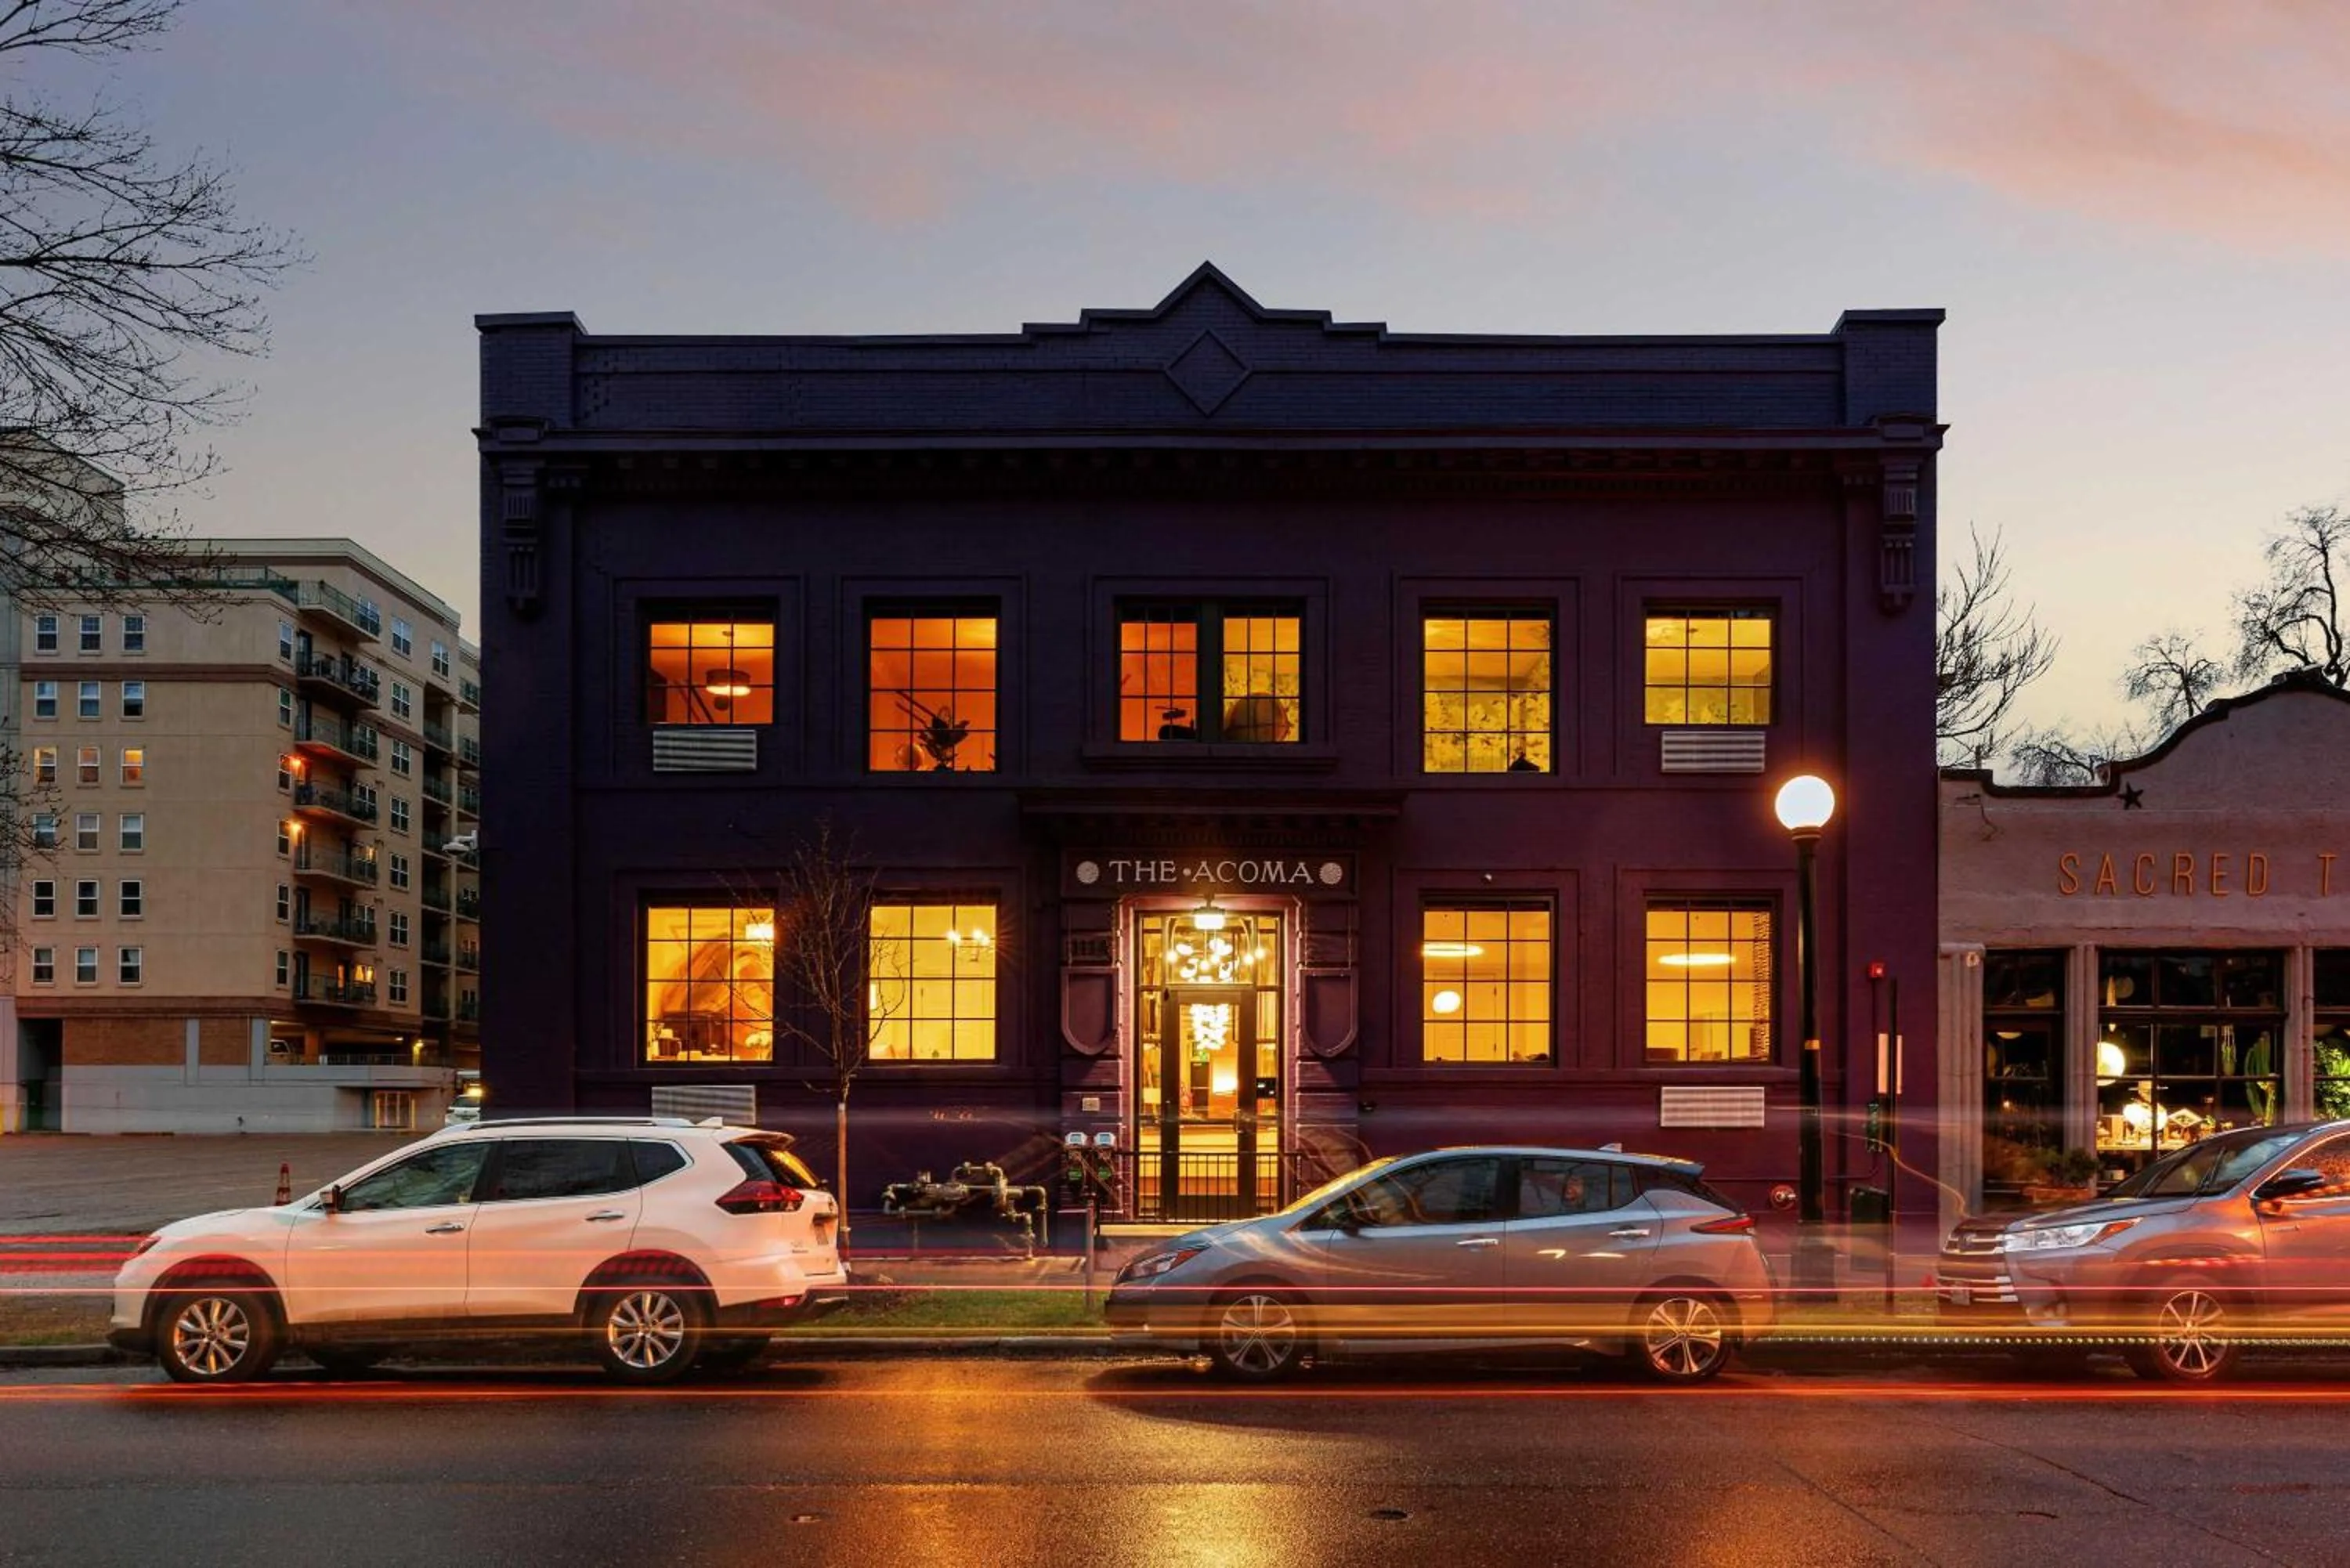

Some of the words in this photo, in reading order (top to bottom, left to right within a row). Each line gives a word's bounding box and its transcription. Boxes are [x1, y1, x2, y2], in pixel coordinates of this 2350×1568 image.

[1109, 861, 1177, 883] THE
[1191, 861, 1314, 883] ACOMA
[2058, 852, 2269, 896] SACRED
[2318, 853, 2337, 897] T
